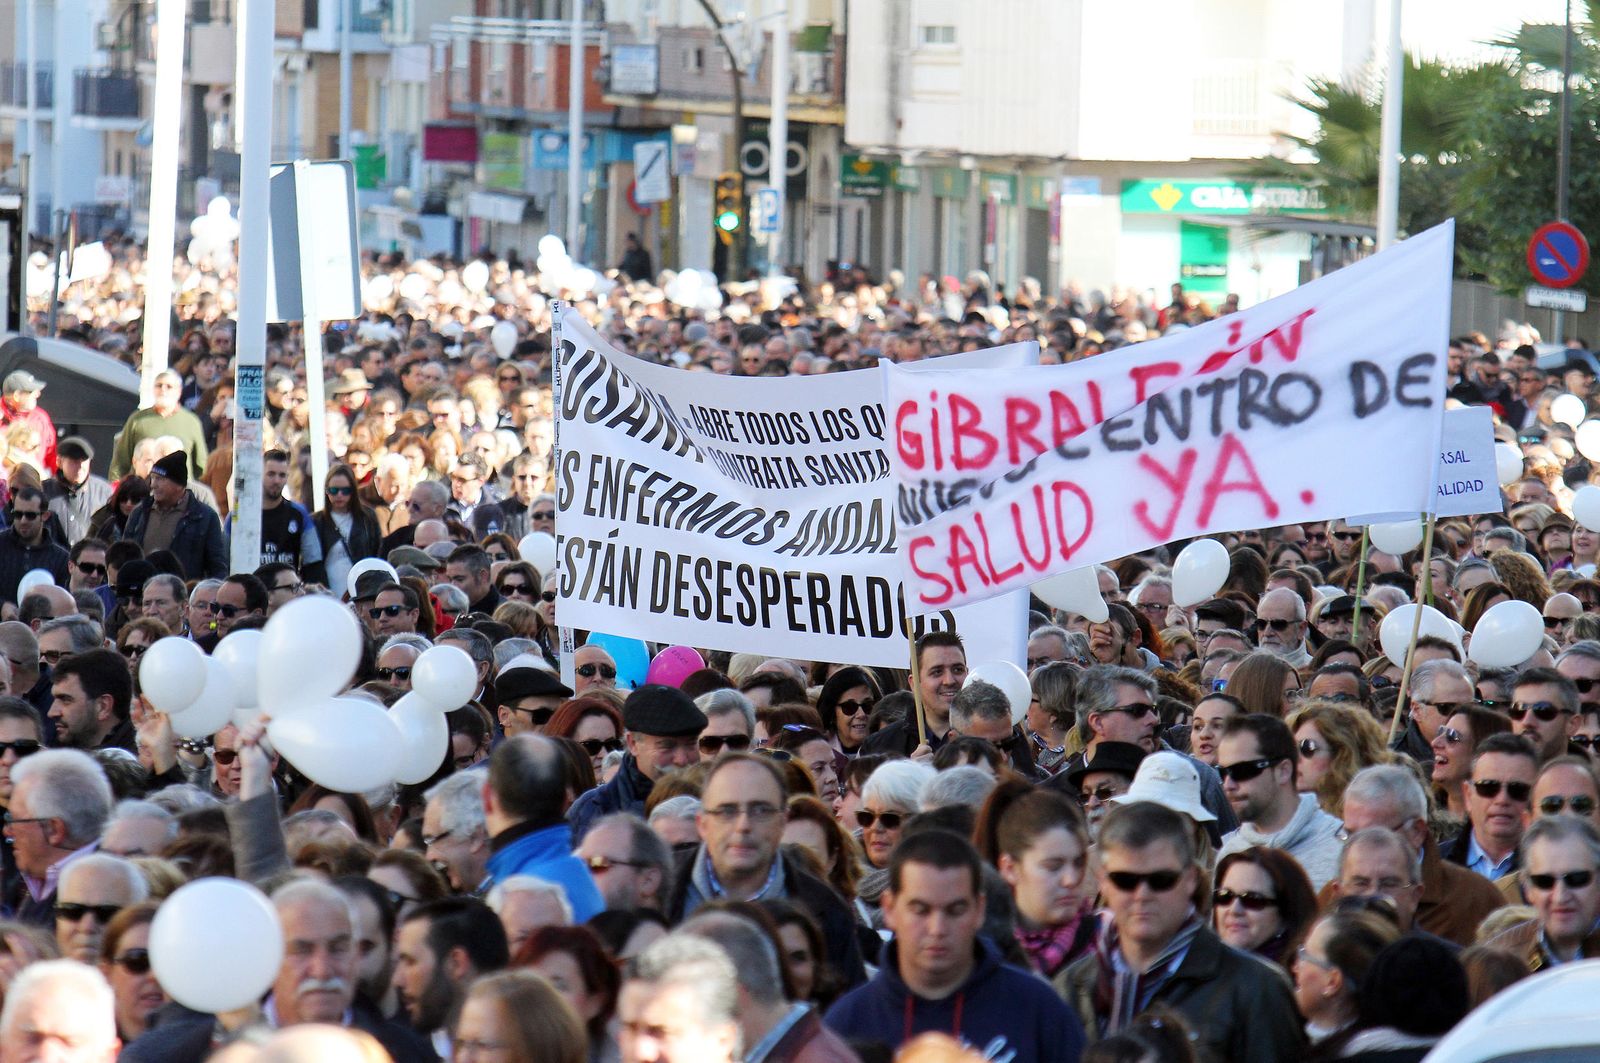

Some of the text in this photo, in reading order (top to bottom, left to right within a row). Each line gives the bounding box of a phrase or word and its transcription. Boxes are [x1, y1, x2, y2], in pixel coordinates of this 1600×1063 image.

[1348, 352, 1437, 419] DE
[688, 404, 740, 443] ABRE
[734, 410, 811, 446] TODOS
[808, 407, 861, 443] LOS
[556, 449, 581, 512] S
[583, 453, 791, 546] ENFERMOS
[706, 446, 809, 489] CONTRATA
[909, 480, 1094, 605] SALUD
